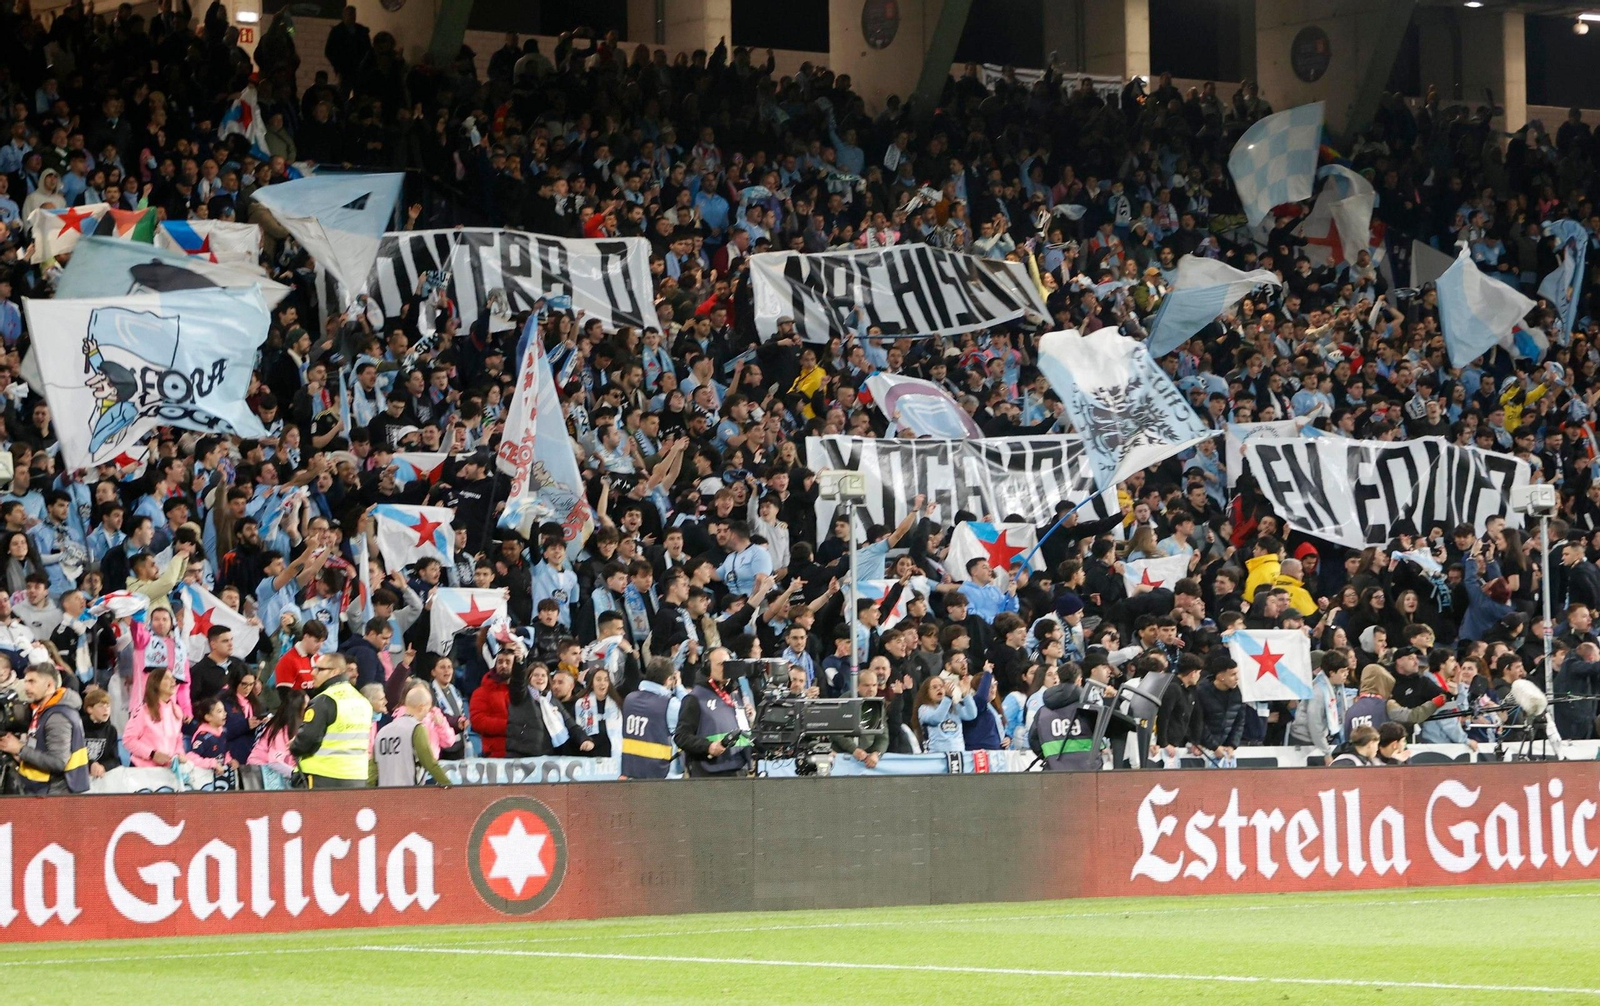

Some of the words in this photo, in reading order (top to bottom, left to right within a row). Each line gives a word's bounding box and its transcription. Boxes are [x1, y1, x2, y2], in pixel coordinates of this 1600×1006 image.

[325, 231, 575, 330] ONTRA
[596, 242, 644, 329] O
[1256, 443, 1344, 537] EN
[626, 714, 649, 737] 017
[104, 807, 441, 923] Galicia
[1130, 782, 1411, 883] Estrella
[1425, 778, 1600, 874] Galic
